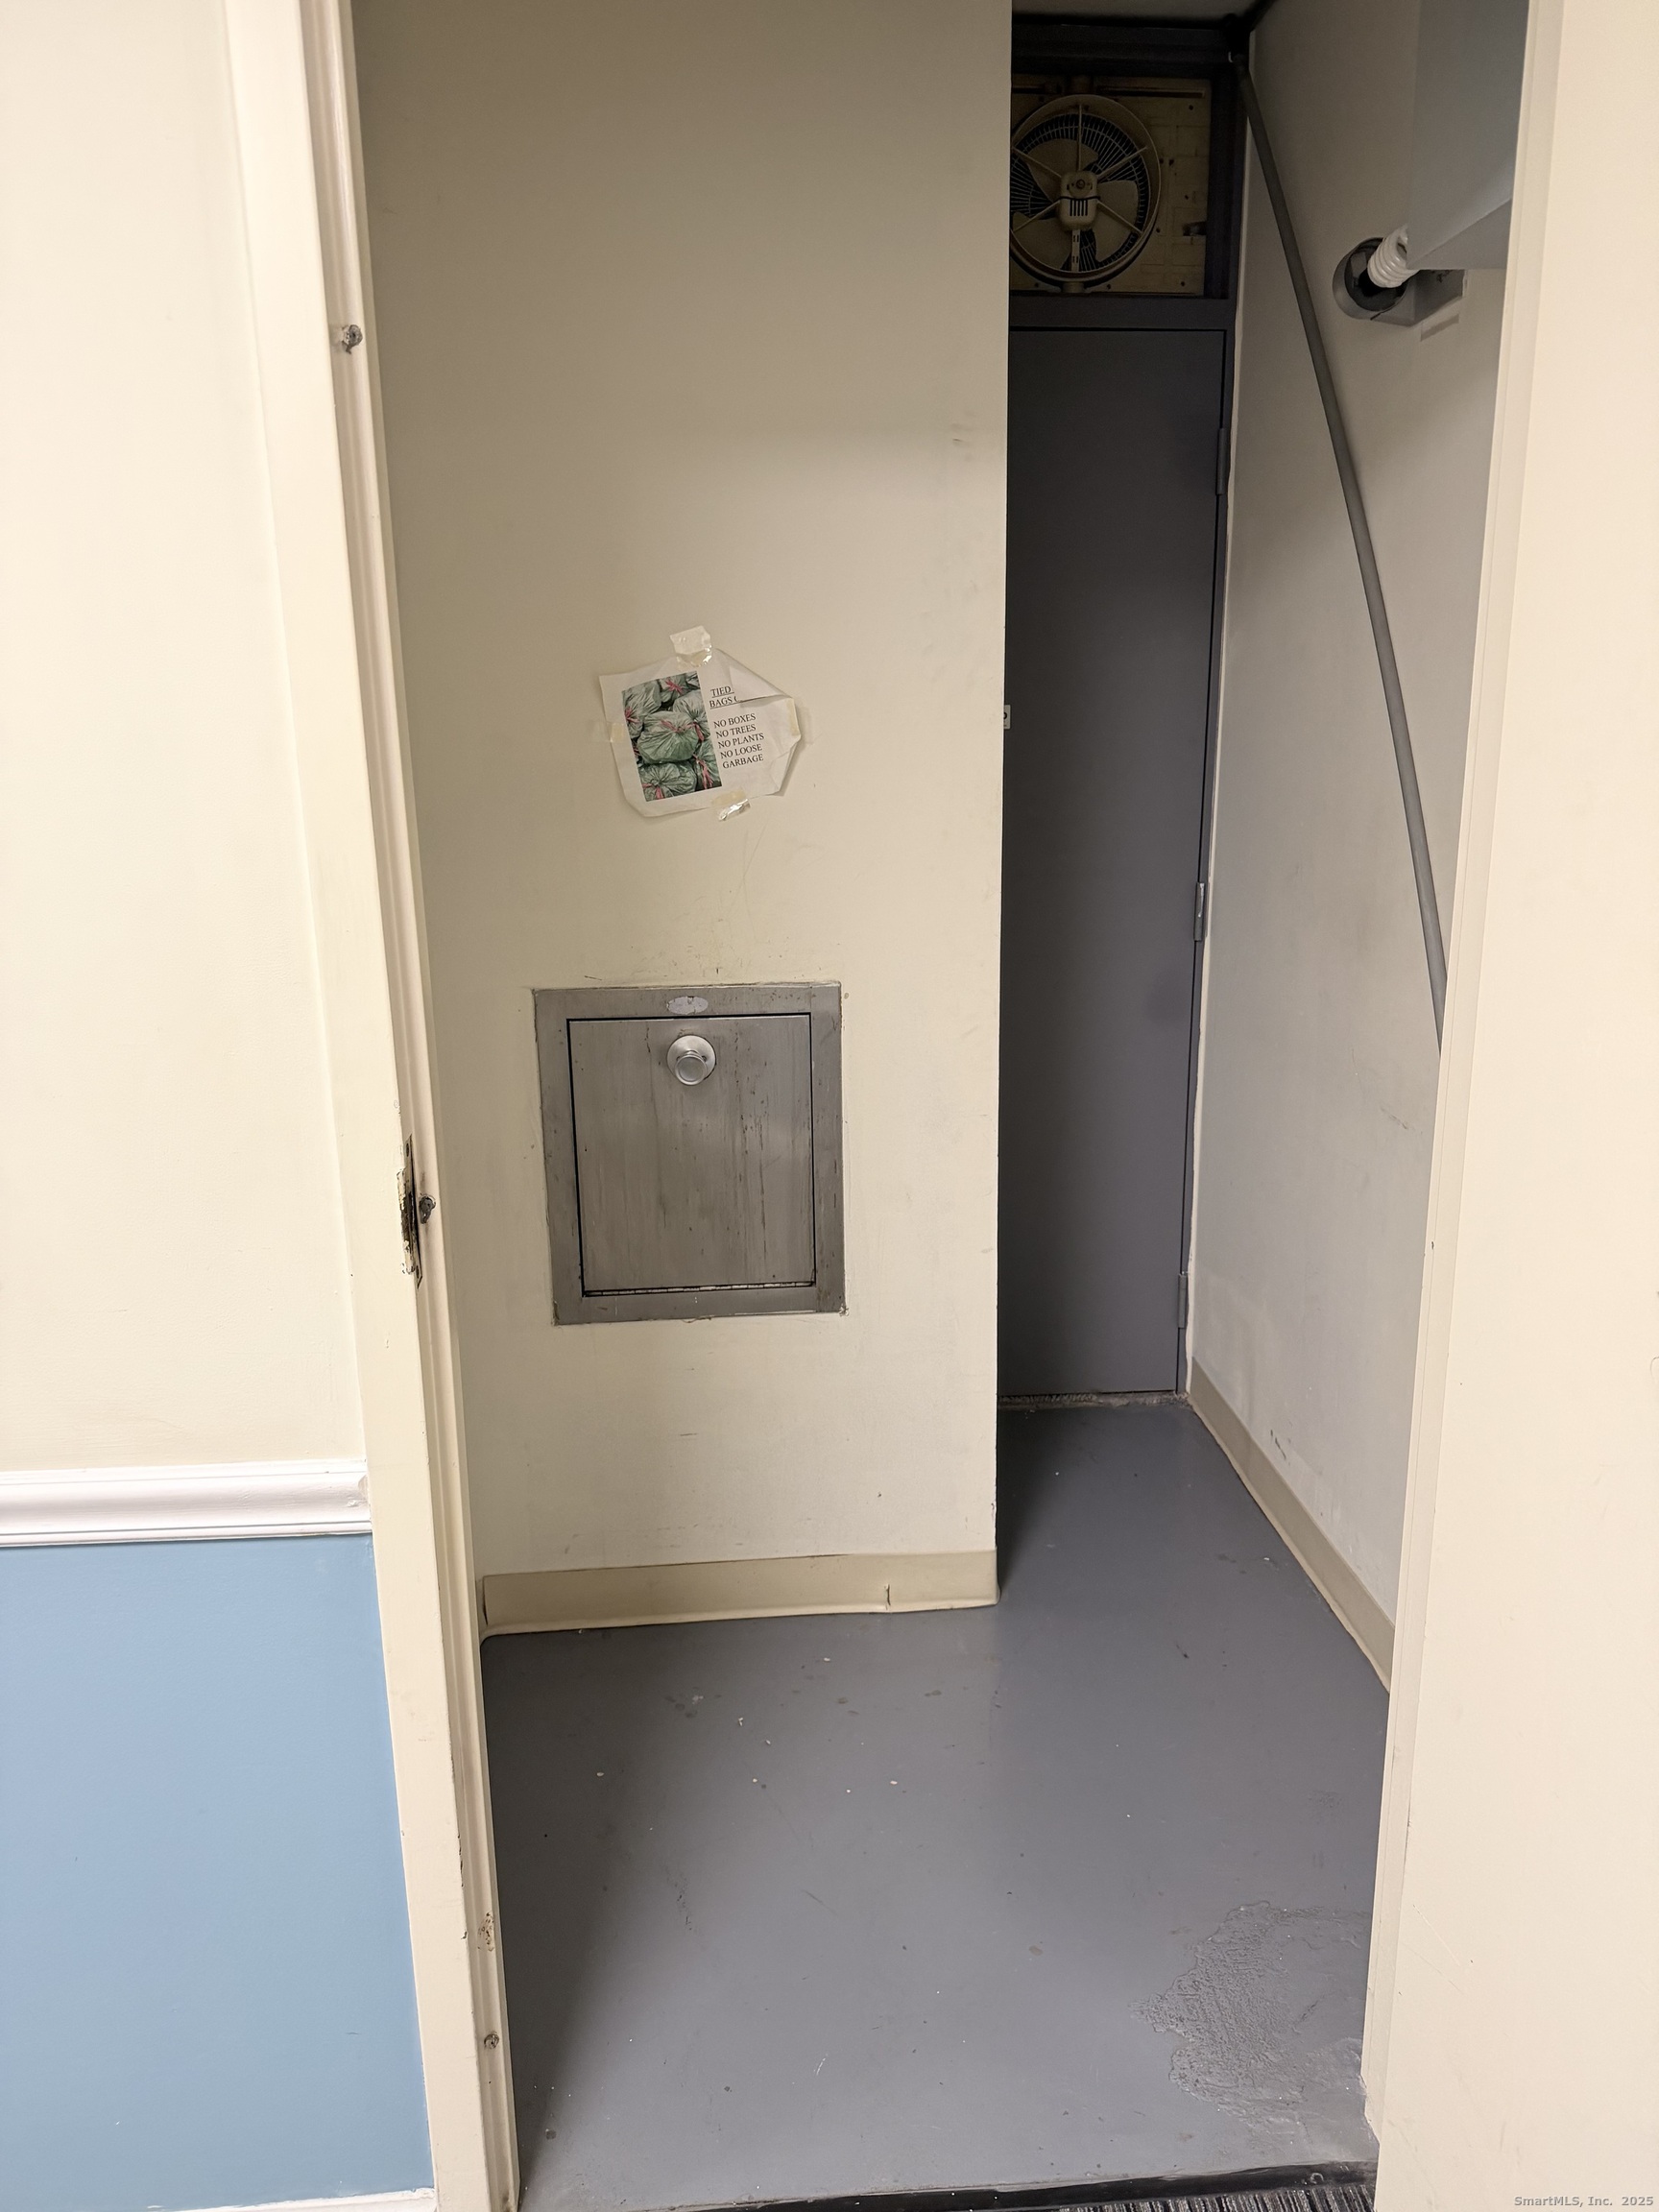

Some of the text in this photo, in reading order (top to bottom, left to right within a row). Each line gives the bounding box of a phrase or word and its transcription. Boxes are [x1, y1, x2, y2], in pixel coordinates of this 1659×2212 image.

[710, 685, 732, 697] TIED
[709, 696, 733, 708] BAGS
[713, 713, 757, 729] NO BOXES
[716, 724, 757, 738] NO TREES
[717, 733, 764, 749] NO PLANTS
[720, 743, 762, 759] NO LOOSE
[722, 754, 764, 769] GARBAGE
